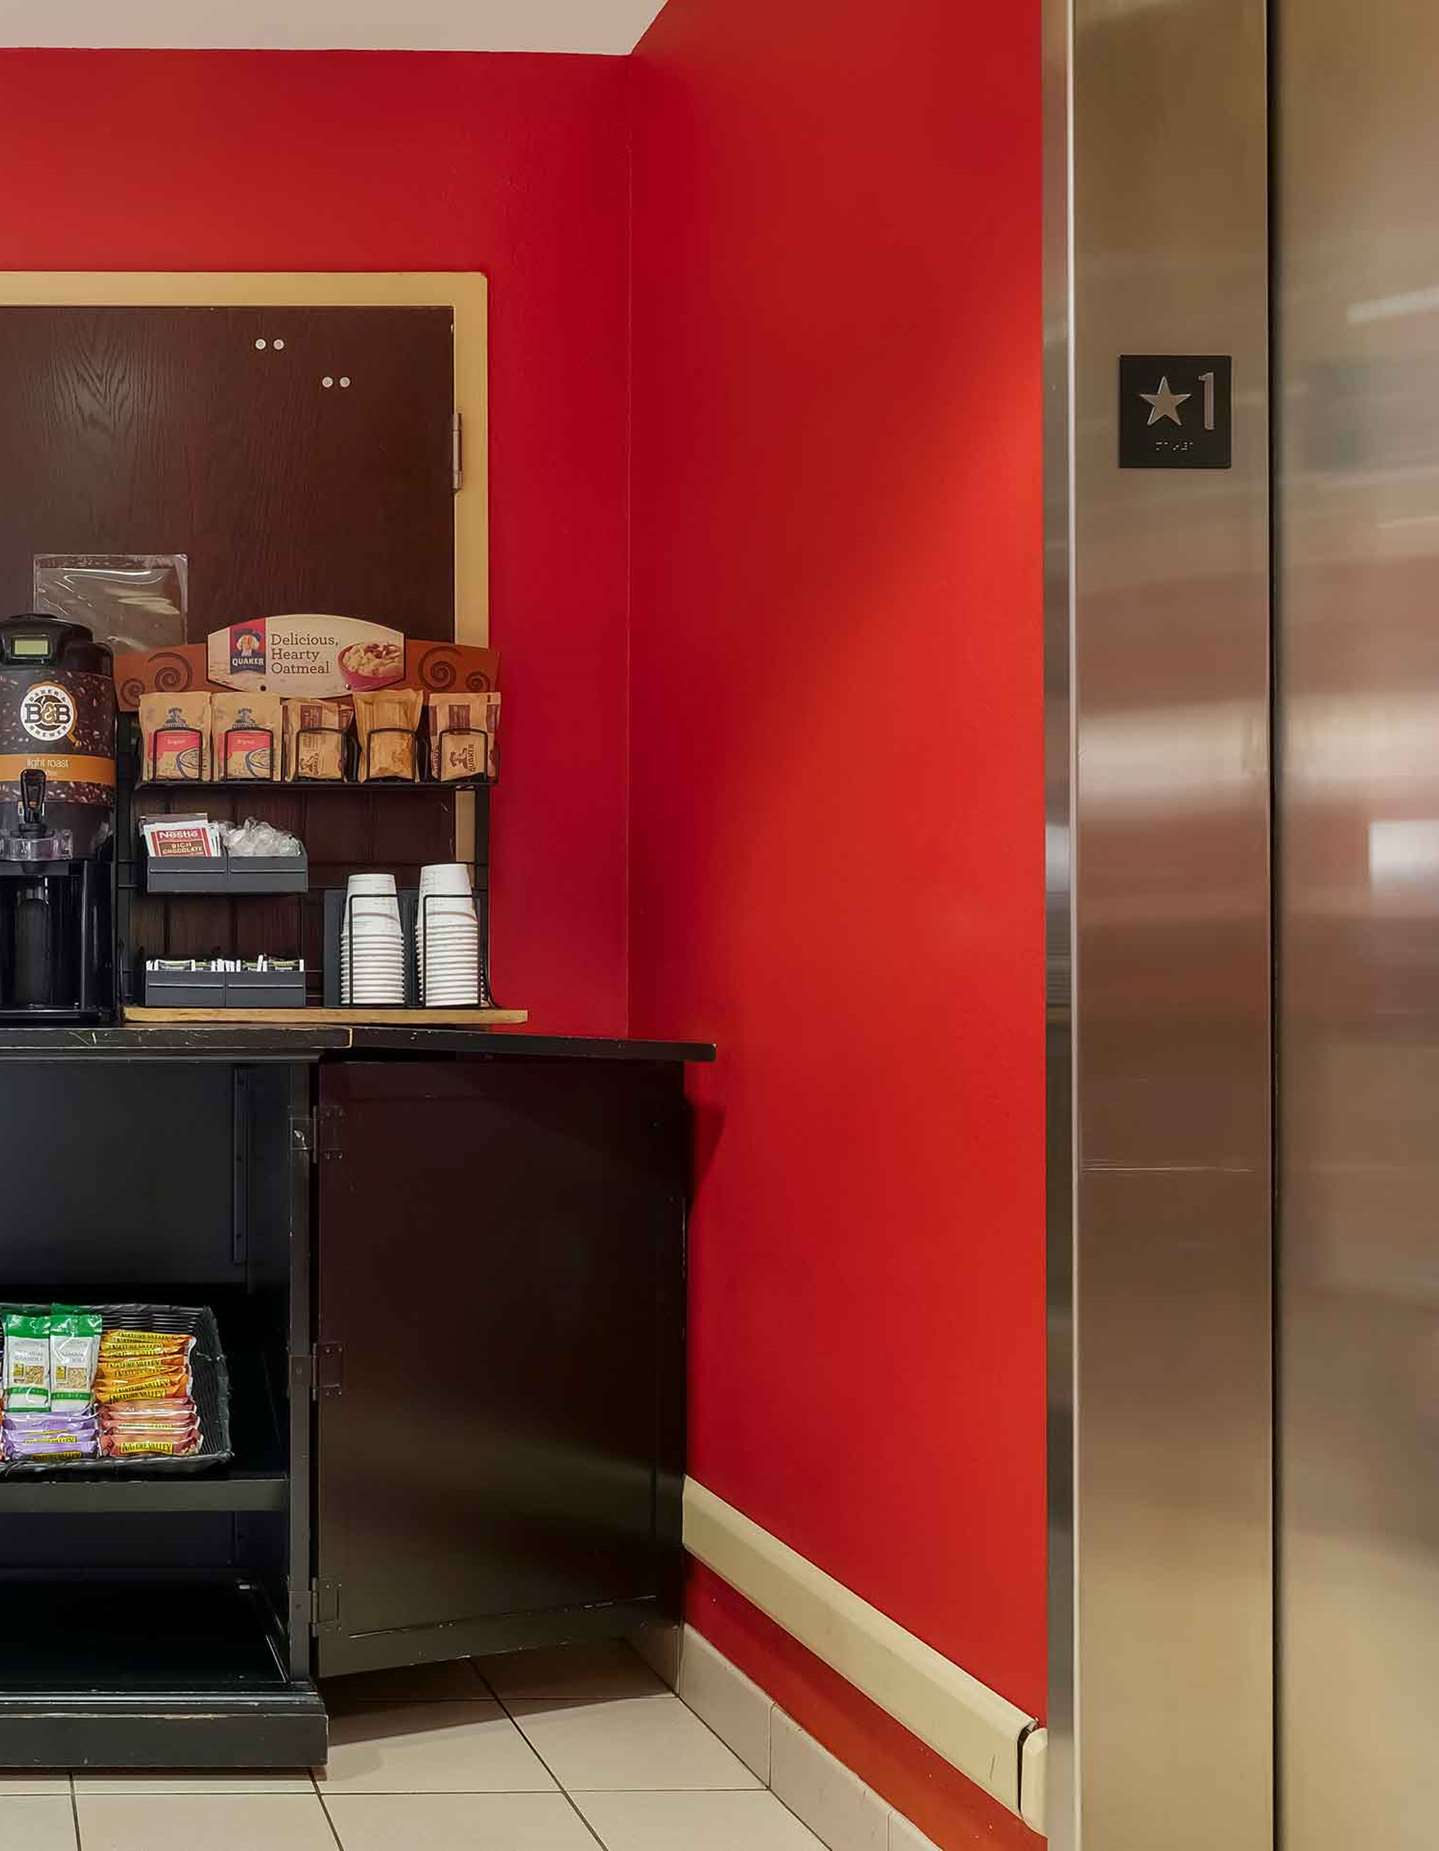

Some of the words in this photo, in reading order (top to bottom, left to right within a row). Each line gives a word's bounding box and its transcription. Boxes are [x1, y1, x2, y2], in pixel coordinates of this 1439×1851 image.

[1198, 371, 1215, 431] 1
[271, 633, 339, 648] Delicious,
[232, 657, 264, 666] QUAKER
[271, 648, 320, 662] Hearty
[271, 661, 330, 674] Oatmeal
[24, 702, 71, 725] B&B
